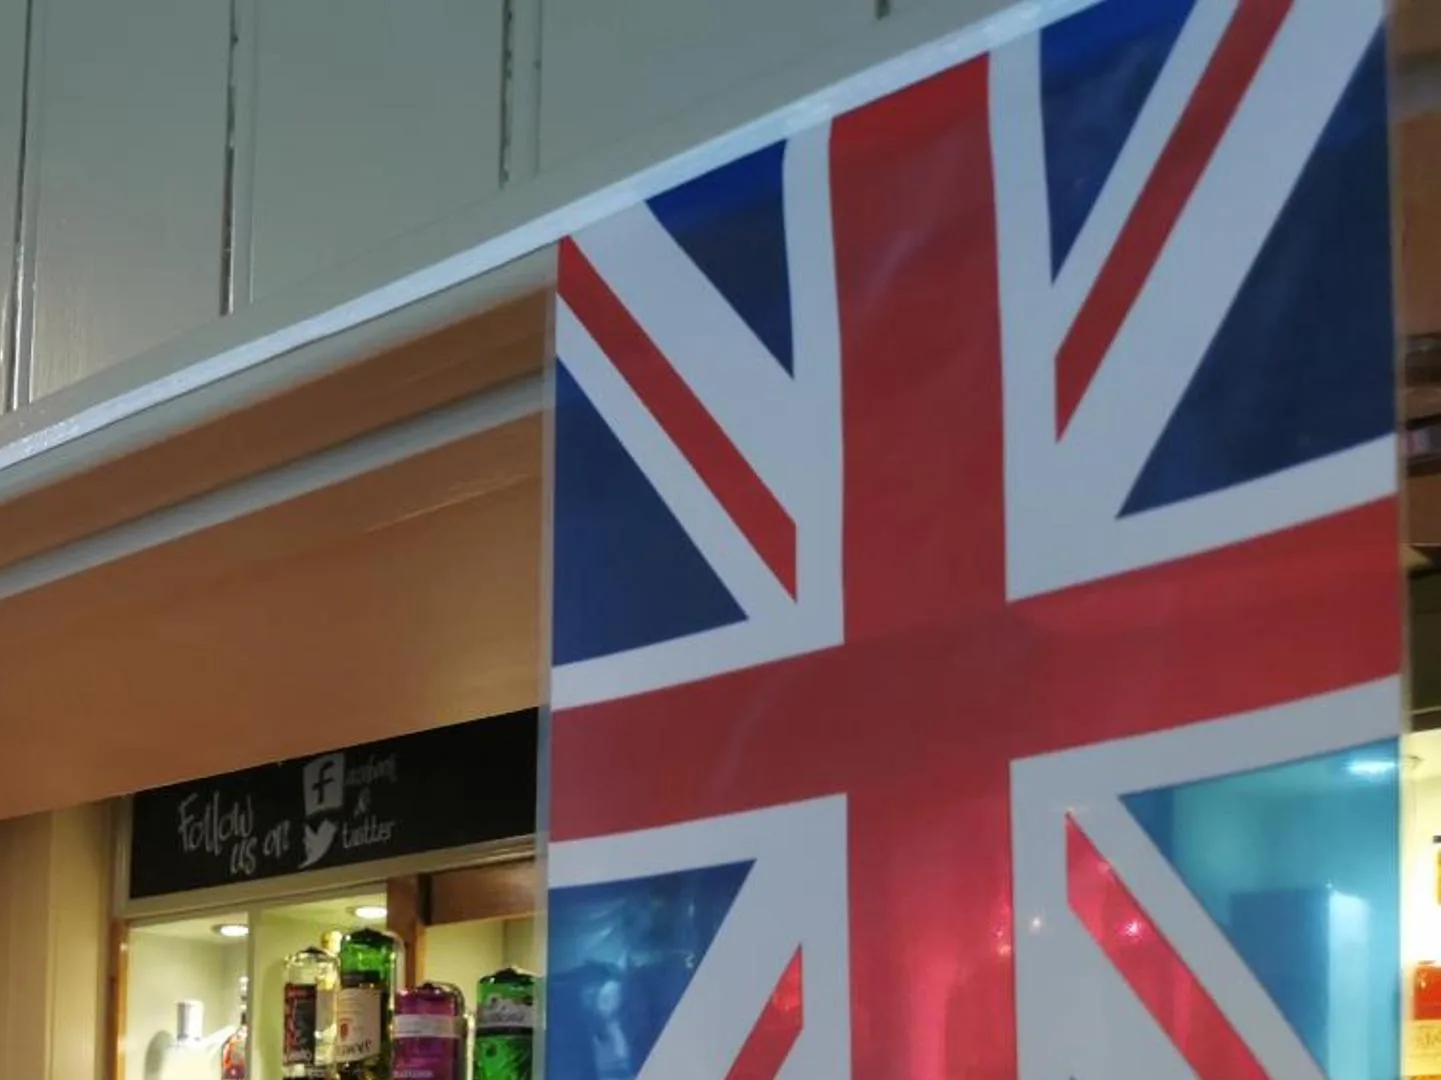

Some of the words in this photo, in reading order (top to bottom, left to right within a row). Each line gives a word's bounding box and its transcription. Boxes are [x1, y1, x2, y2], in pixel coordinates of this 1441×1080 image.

[178, 789, 254, 857] Follow
[229, 836, 257, 876] us
[262, 819, 291, 859] on
[341, 814, 397, 849] twitter
